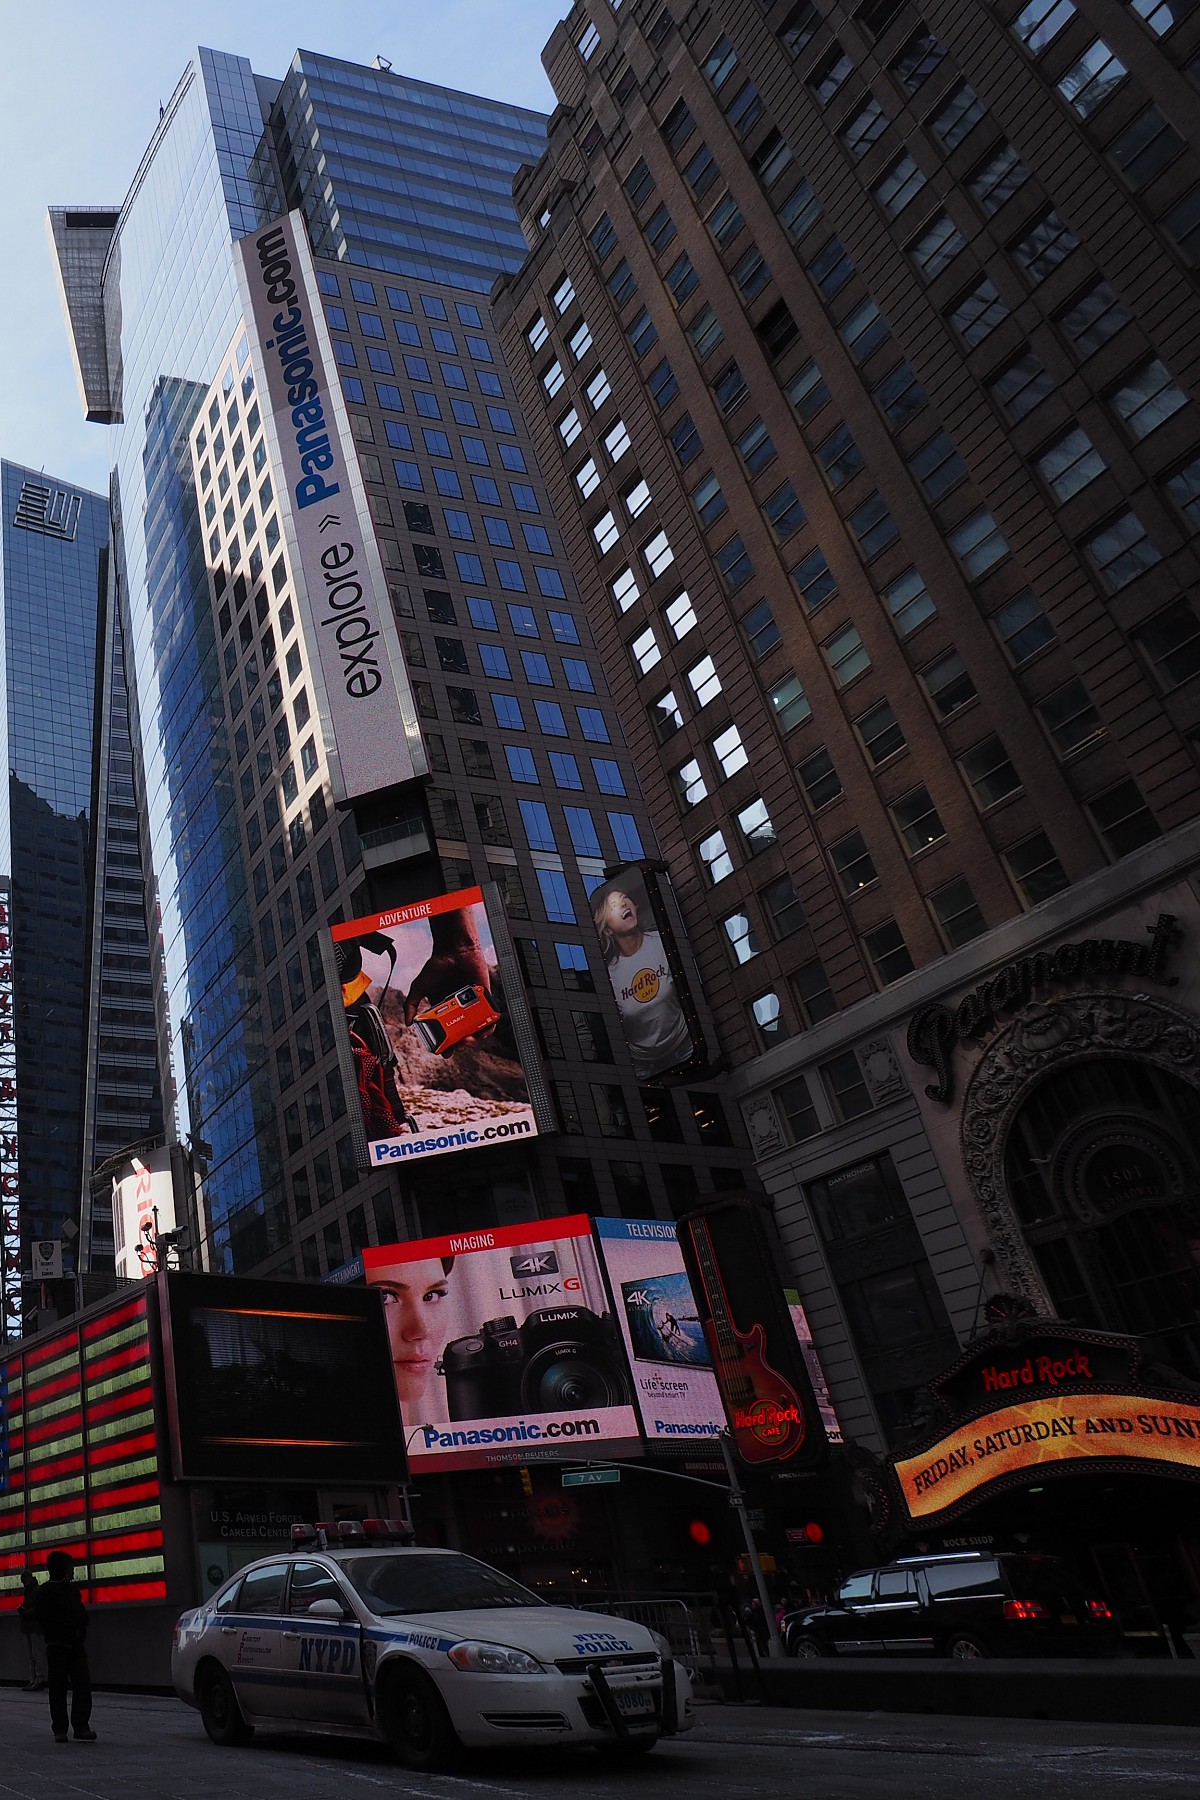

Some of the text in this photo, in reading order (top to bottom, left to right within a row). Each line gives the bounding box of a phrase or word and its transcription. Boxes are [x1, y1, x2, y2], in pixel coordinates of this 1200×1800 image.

[255, 226, 341, 510] Panasonic.com
[320, 541, 382, 699] explore
[379, 903, 432, 927] ADVENTURE
[621, 965, 667, 1000] Hard Rock
[907, 914, 1183, 1102] Paramount
[445, 1014, 465, 1027] LUMIX
[375, 1120, 531, 1160] Panasonic.com
[828, 1164, 876, 1187] DAKTRONICS
[1103, 1165, 1144, 1189] 1501
[1103, 1184, 1162, 1211] BROADWAY
[449, 1233, 495, 1253] IMAGING
[515, 1255, 554, 1274] 4K
[499, 1277, 581, 1301] LUMIX G
[627, 1289, 652, 1305] 4K
[539, 1310, 579, 1323] LUMIX
[498, 1339, 518, 1348] GH4
[982, 1347, 1093, 1392] Hard Rock
[735, 1404, 801, 1429] Hard Rock
[423, 1417, 600, 1448] Panasonic.com
[485, 1453, 523, 1463] THOMSON
[913, 1445, 976, 1495] FRIDAY,
[974, 1415, 1076, 1458] SATURDAY
[1085, 1418, 1133, 1434] AND
[579, 1474, 585, 1482] 7
[210, 1511, 304, 1523] U.S. ARMED FORCES
[220, 1525, 291, 1537] CAREER CENTE
[942, 1535, 994, 1548] ROCK SHOP
[408, 1634, 438, 1650] POLICE
[573, 1633, 616, 1642] NYPD
[573, 1640, 633, 1655] POLICE
[299, 1637, 356, 1674] NYPD
[617, 1692, 644, 1709] 3080
